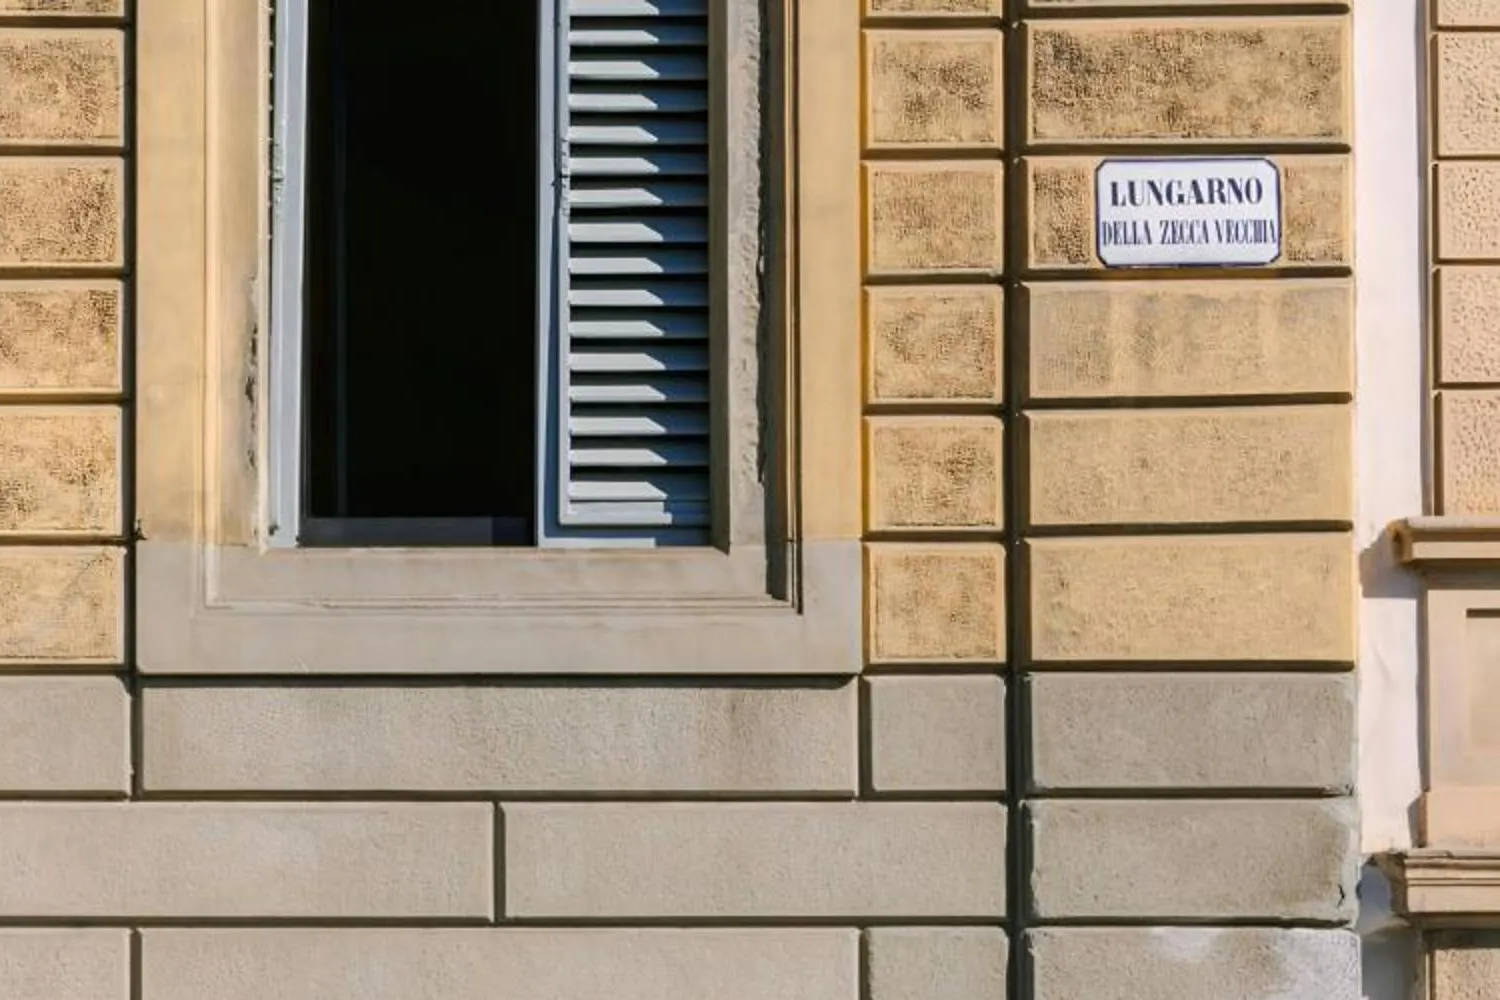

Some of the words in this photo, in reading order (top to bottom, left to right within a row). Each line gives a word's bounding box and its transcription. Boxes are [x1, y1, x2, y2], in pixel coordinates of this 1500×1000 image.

[1110, 177, 1263, 207] LUNGARNO
[1102, 219, 1153, 246] DELLA
[1159, 219, 1210, 245] ZECCA
[1214, 218, 1277, 245] VECCHIA
